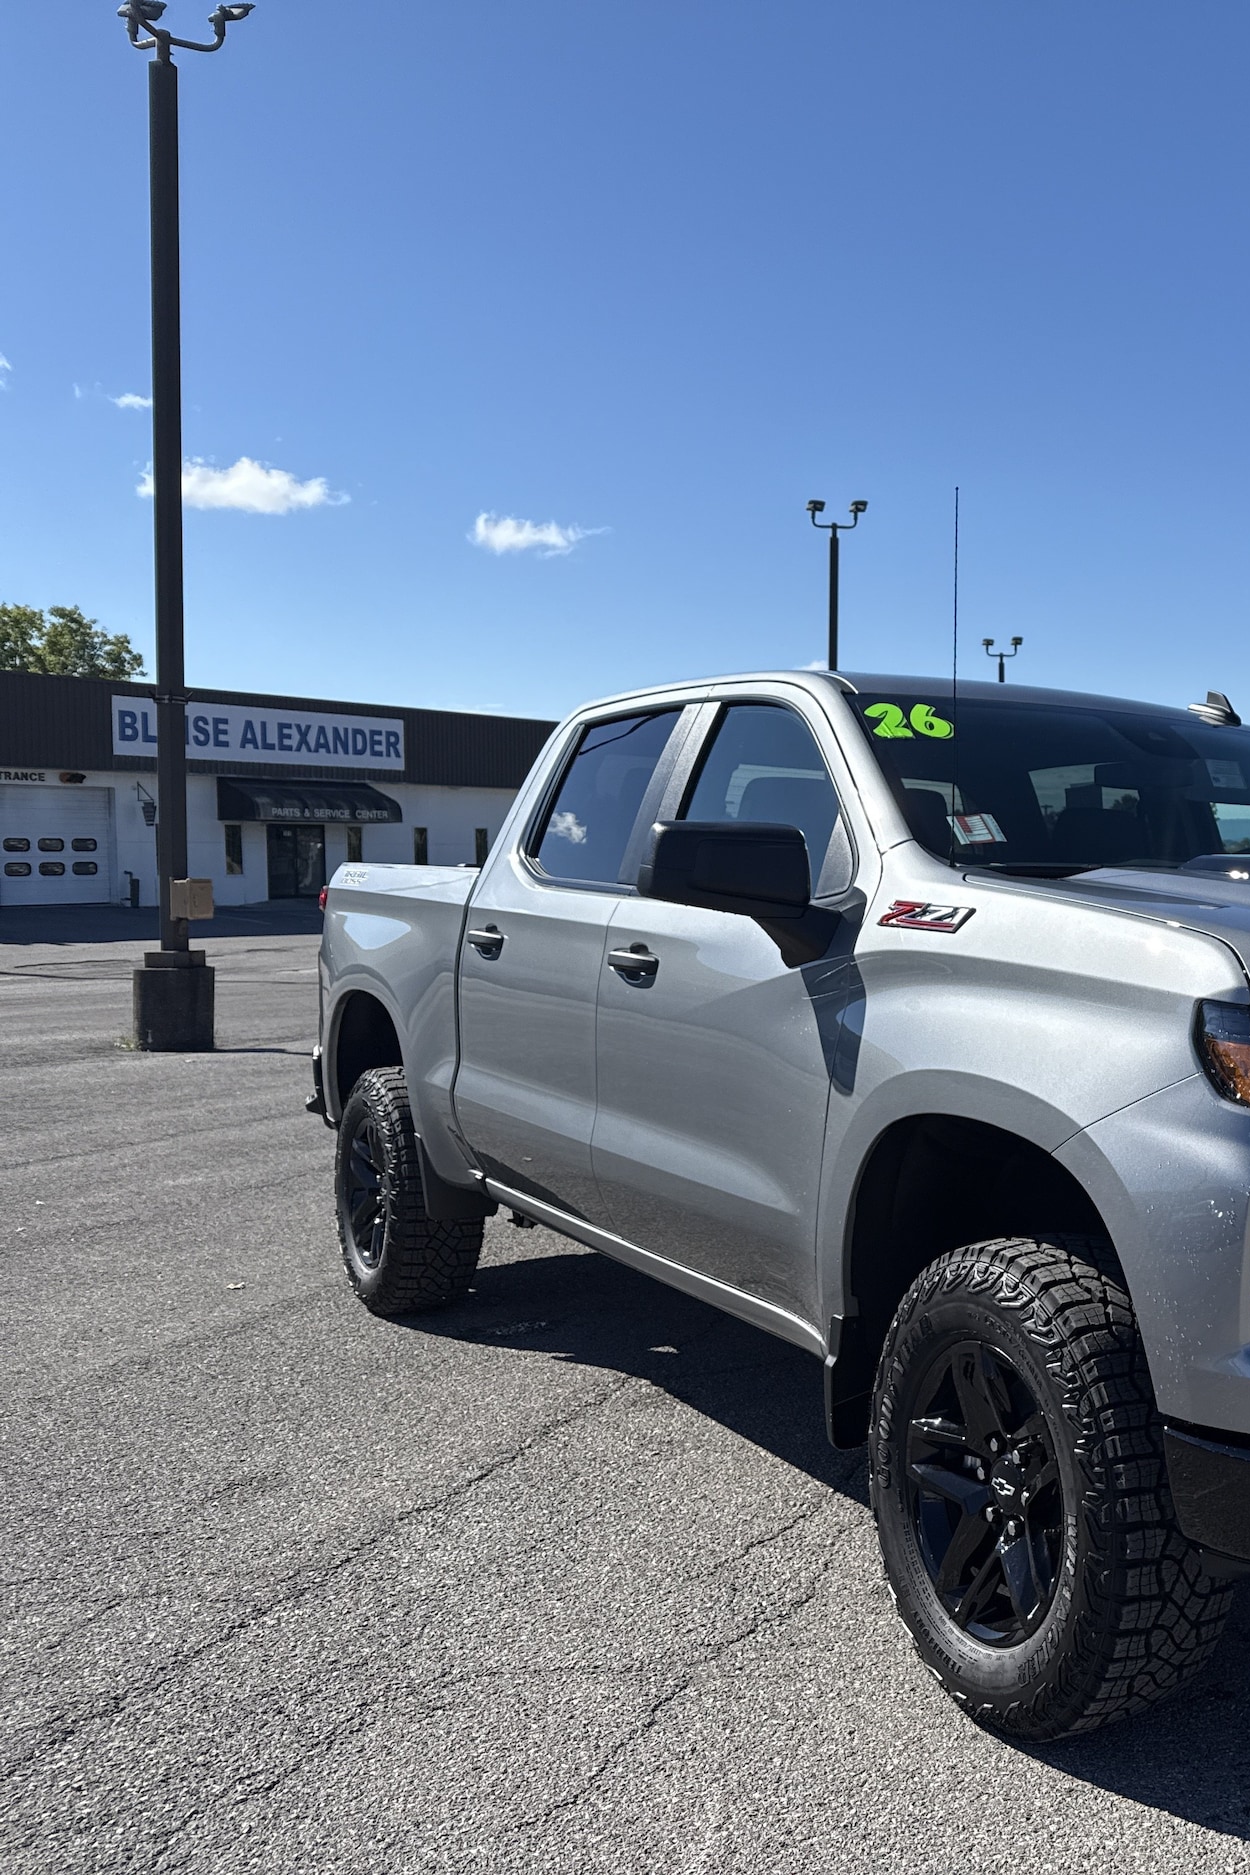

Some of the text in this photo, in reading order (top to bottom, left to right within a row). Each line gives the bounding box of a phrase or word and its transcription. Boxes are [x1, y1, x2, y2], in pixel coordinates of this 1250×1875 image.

[117, 709, 402, 759] BLISE ALEXANDER
[863, 702, 955, 740] 26
[271, 807, 389, 819] PARTS & SERVICE CENTER
[877, 899, 977, 935] Z71
